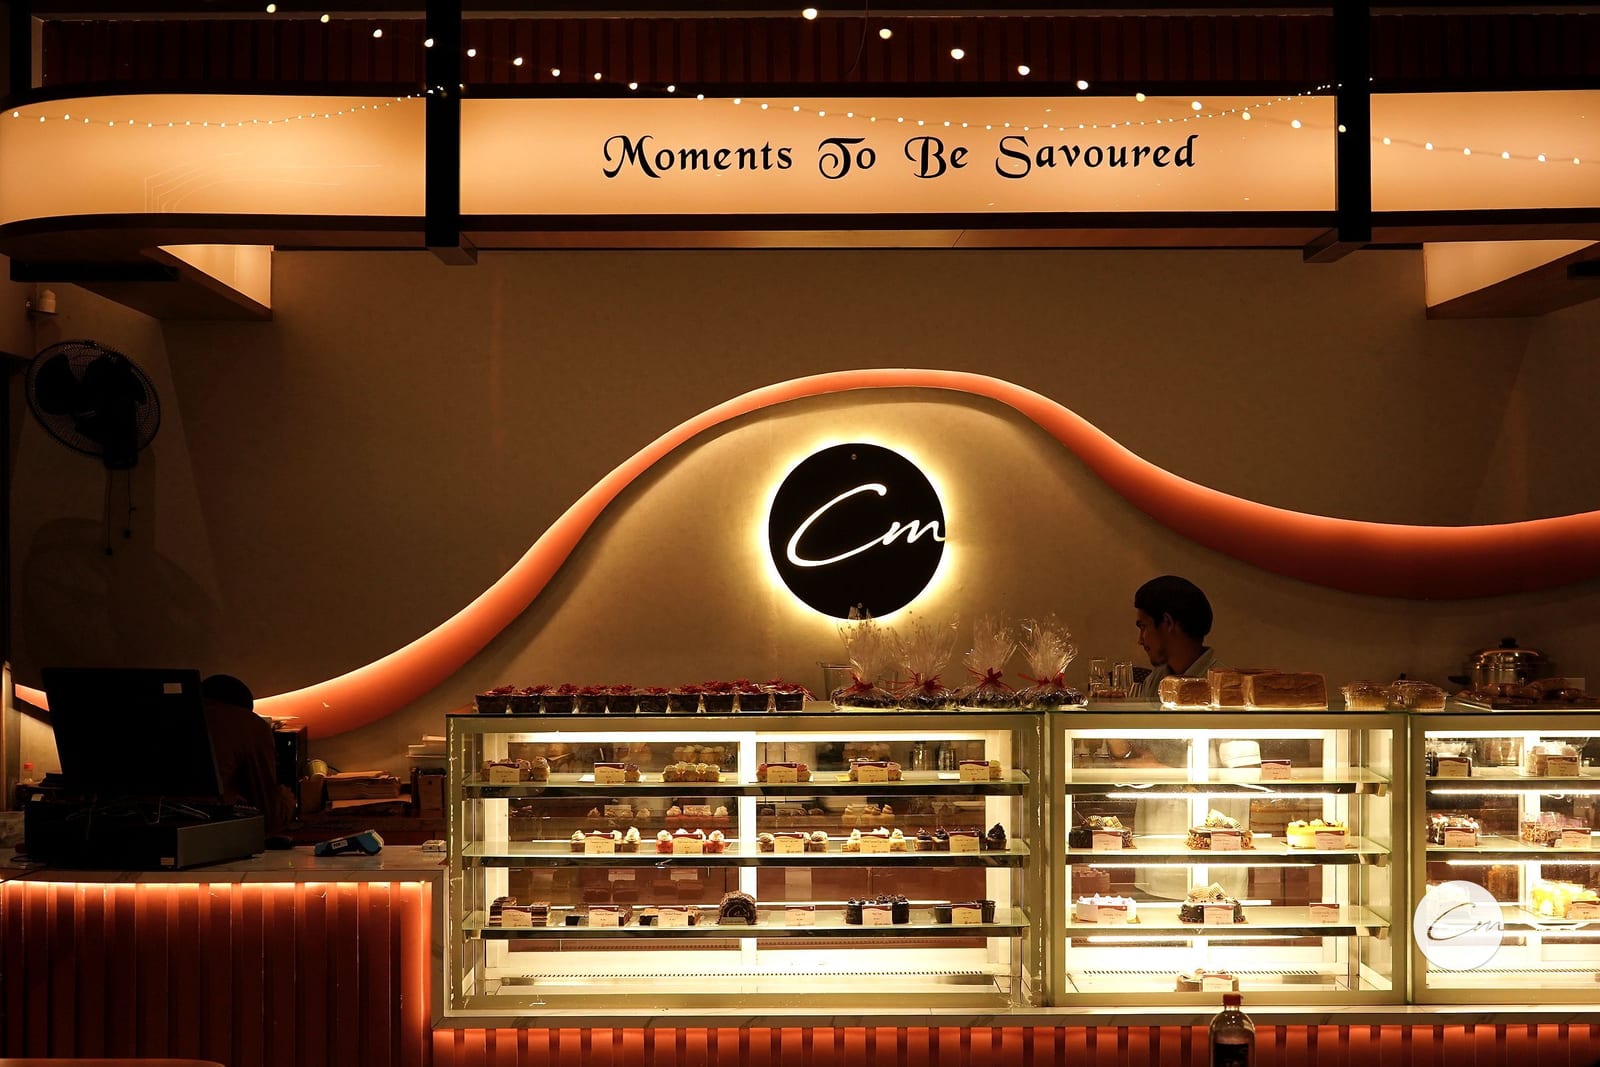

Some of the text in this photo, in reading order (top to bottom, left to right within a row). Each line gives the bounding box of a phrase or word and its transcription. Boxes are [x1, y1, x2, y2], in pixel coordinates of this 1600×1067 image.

[603, 135, 1198, 179] Moments To Be Savoured
[786, 483, 946, 567] Cm
